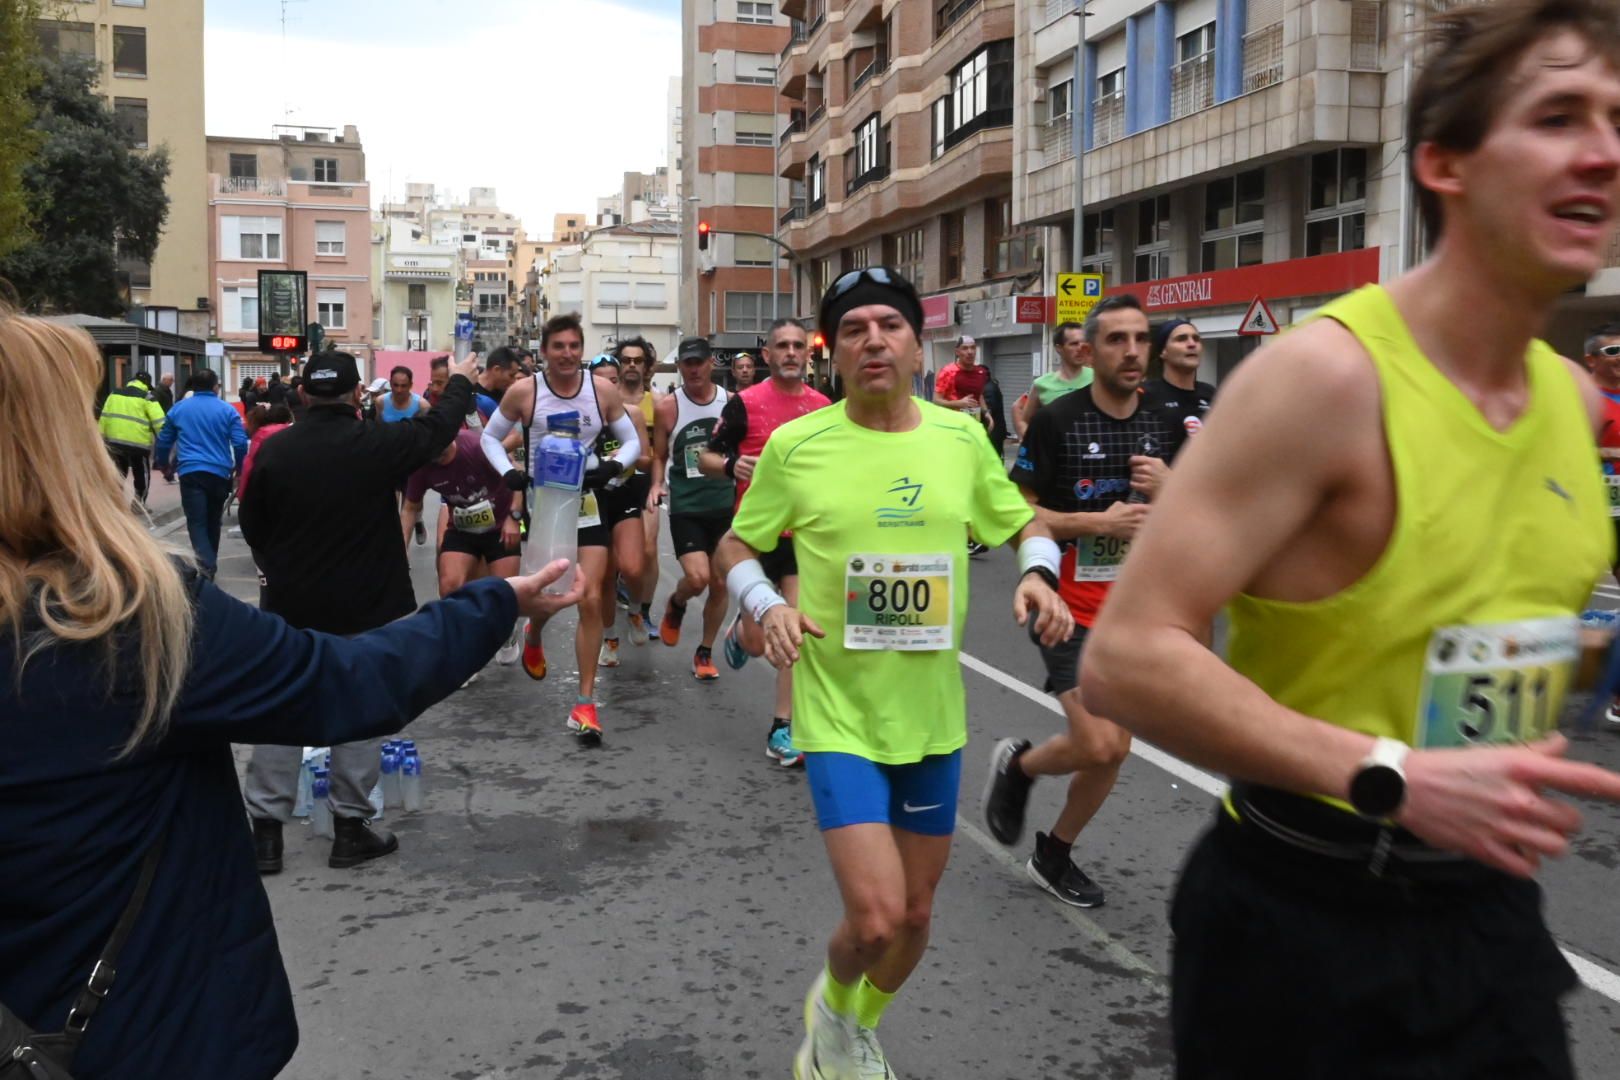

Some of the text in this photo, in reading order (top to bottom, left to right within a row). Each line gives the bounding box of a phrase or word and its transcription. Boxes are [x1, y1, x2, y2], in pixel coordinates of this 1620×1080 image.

[1085, 280, 1097, 295] P
[1161, 278, 1212, 304] GENERALI
[459, 511, 489, 524] 1026
[868, 579, 930, 613] 800
[875, 613, 923, 625] RIPOLL
[1459, 671, 1550, 740] 511
